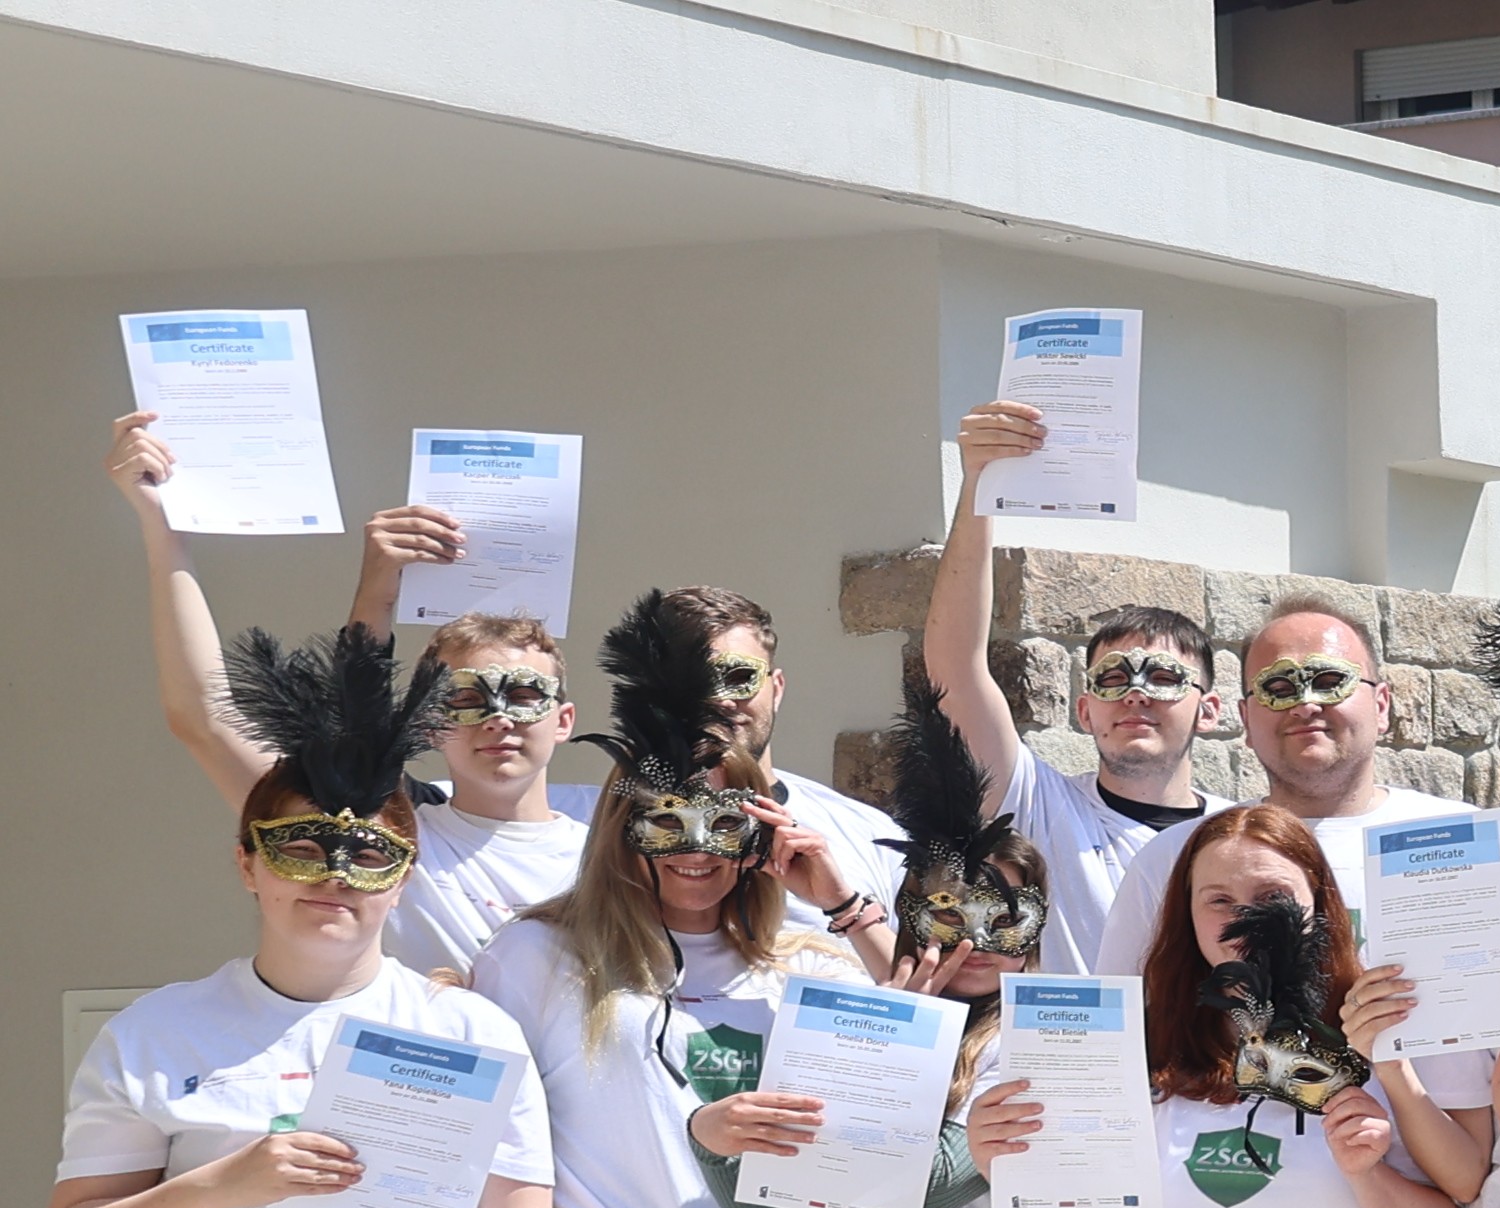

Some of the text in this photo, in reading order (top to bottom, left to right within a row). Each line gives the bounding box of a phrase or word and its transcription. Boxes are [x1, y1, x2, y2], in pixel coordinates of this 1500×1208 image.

[190, 343, 254, 353] Certificate
[1037, 339, 1088, 348] Certificate
[464, 459, 523, 469] Certificate
[1406, 833, 1433, 842] European
[1408, 848, 1464, 863] Certificate
[1403, 864, 1472, 878] Klaudia Dutkowska
[1037, 992, 1060, 1000] European
[837, 998, 889, 1012] European Funds
[1037, 1011, 1090, 1022] Certificate
[834, 1015, 898, 1034] Certificate
[835, 1032, 864, 1043] Amelia
[395, 1045, 449, 1062] European Funds
[692, 1048, 758, 1074] ZSGH
[390, 1063, 456, 1086] Certificate
[384, 1079, 405, 1090] Yana
